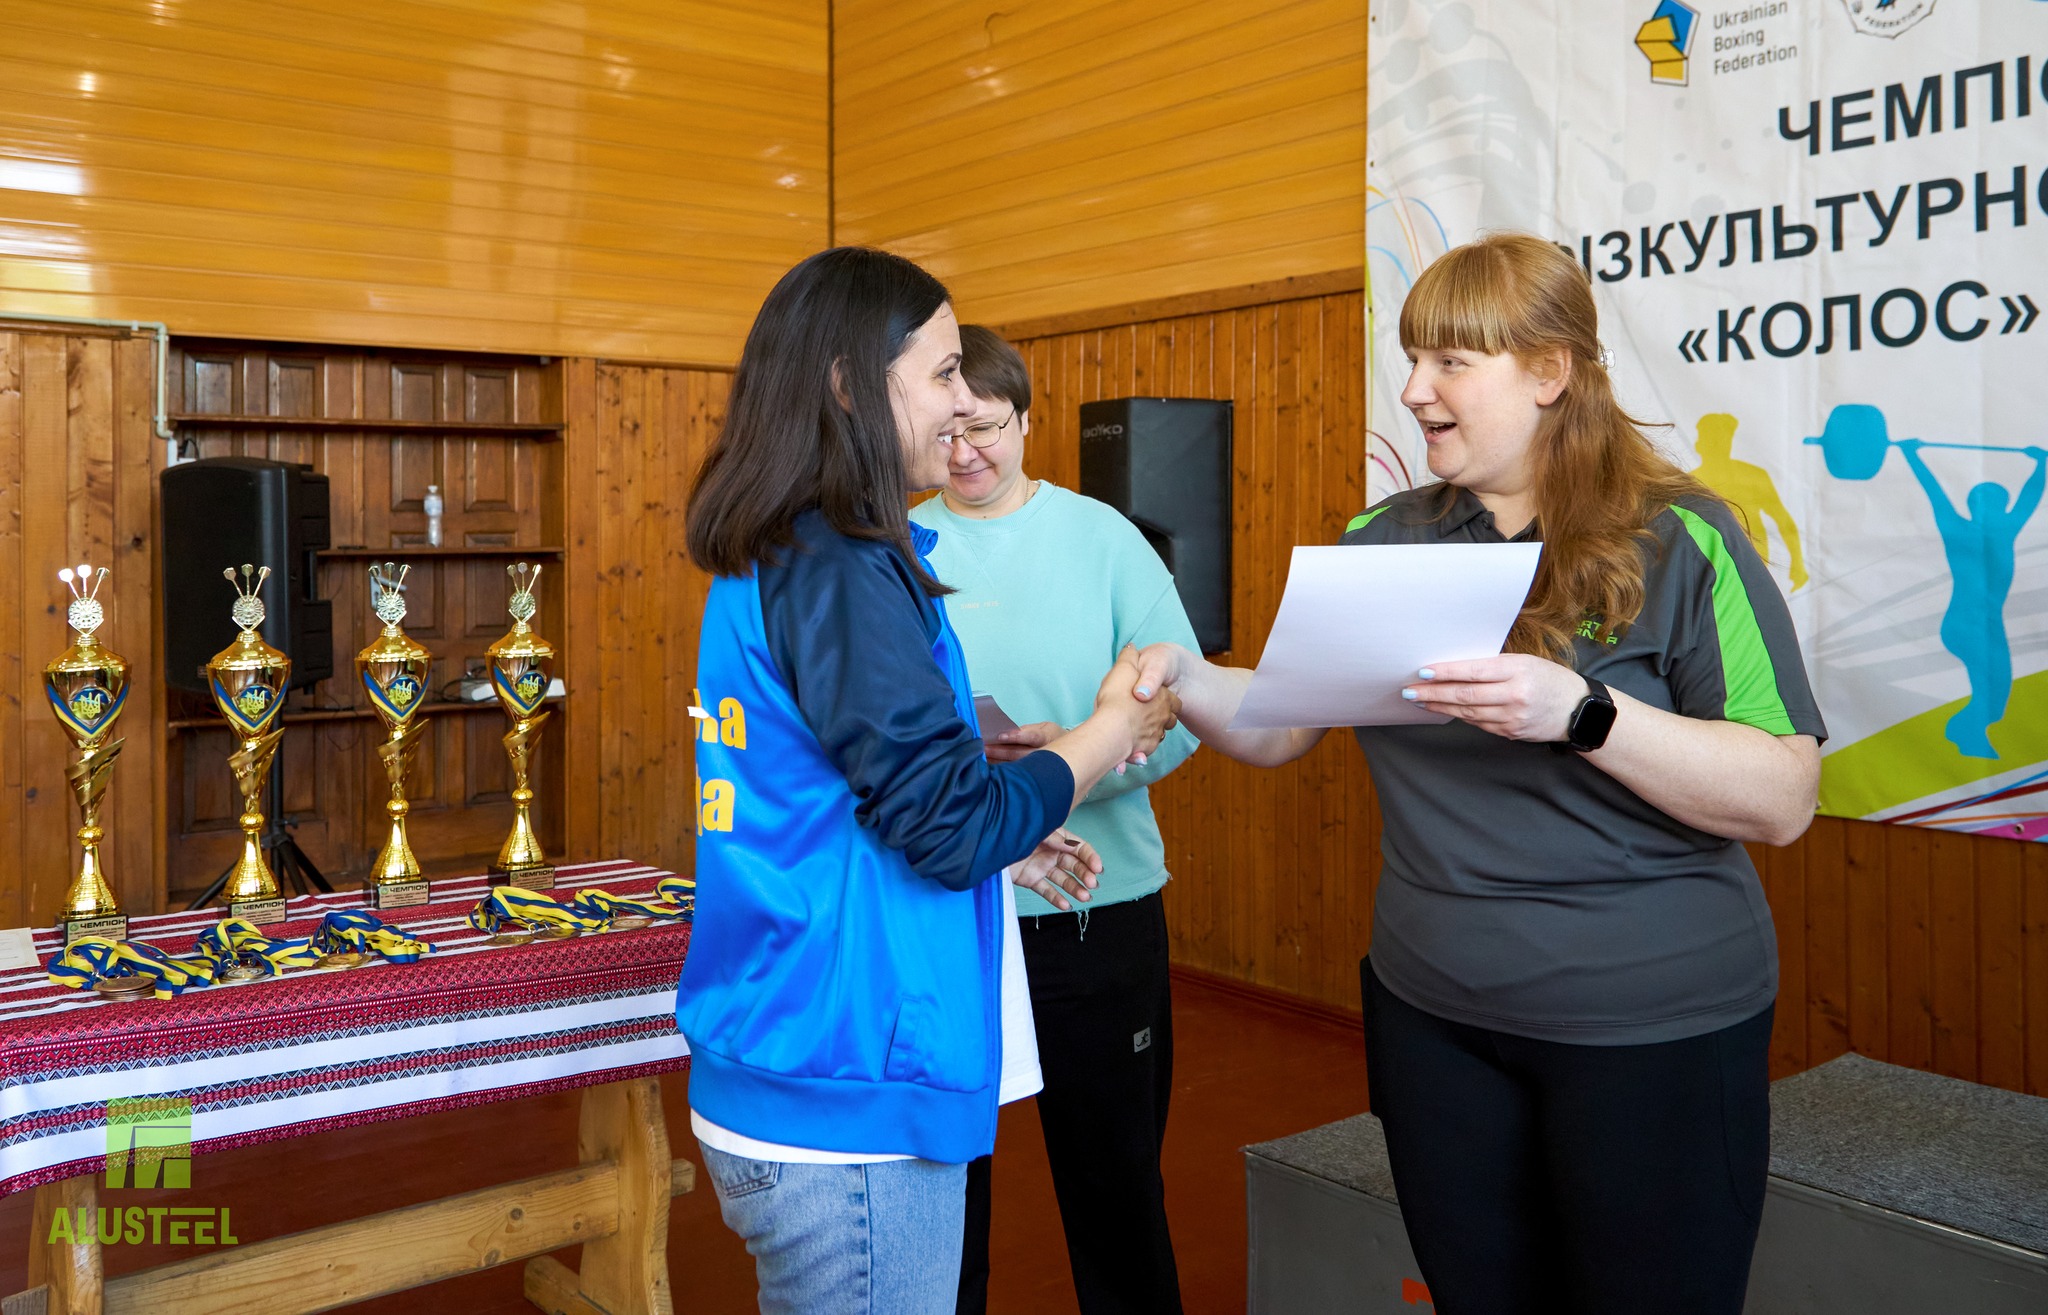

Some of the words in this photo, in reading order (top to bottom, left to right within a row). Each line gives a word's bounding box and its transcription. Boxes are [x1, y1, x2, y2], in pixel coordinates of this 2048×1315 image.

[1713, 1, 1788, 30] Ukrainian
[1713, 29, 1765, 53] Boxing
[1713, 44, 1798, 76] Federation
[1778, 55, 2048, 157] ЧЕМПІ
[1553, 164, 2048, 285] ІЗКУЛЬТУРН
[1677, 279, 2041, 364] «КОЛОС»
[519, 869, 553, 878] ЧЕМПІОН
[390, 884, 428, 893] ЧЕМПІОН
[243, 901, 284, 911] ЧЕМПІОН
[80, 919, 126, 929] ЧЕМПІОН
